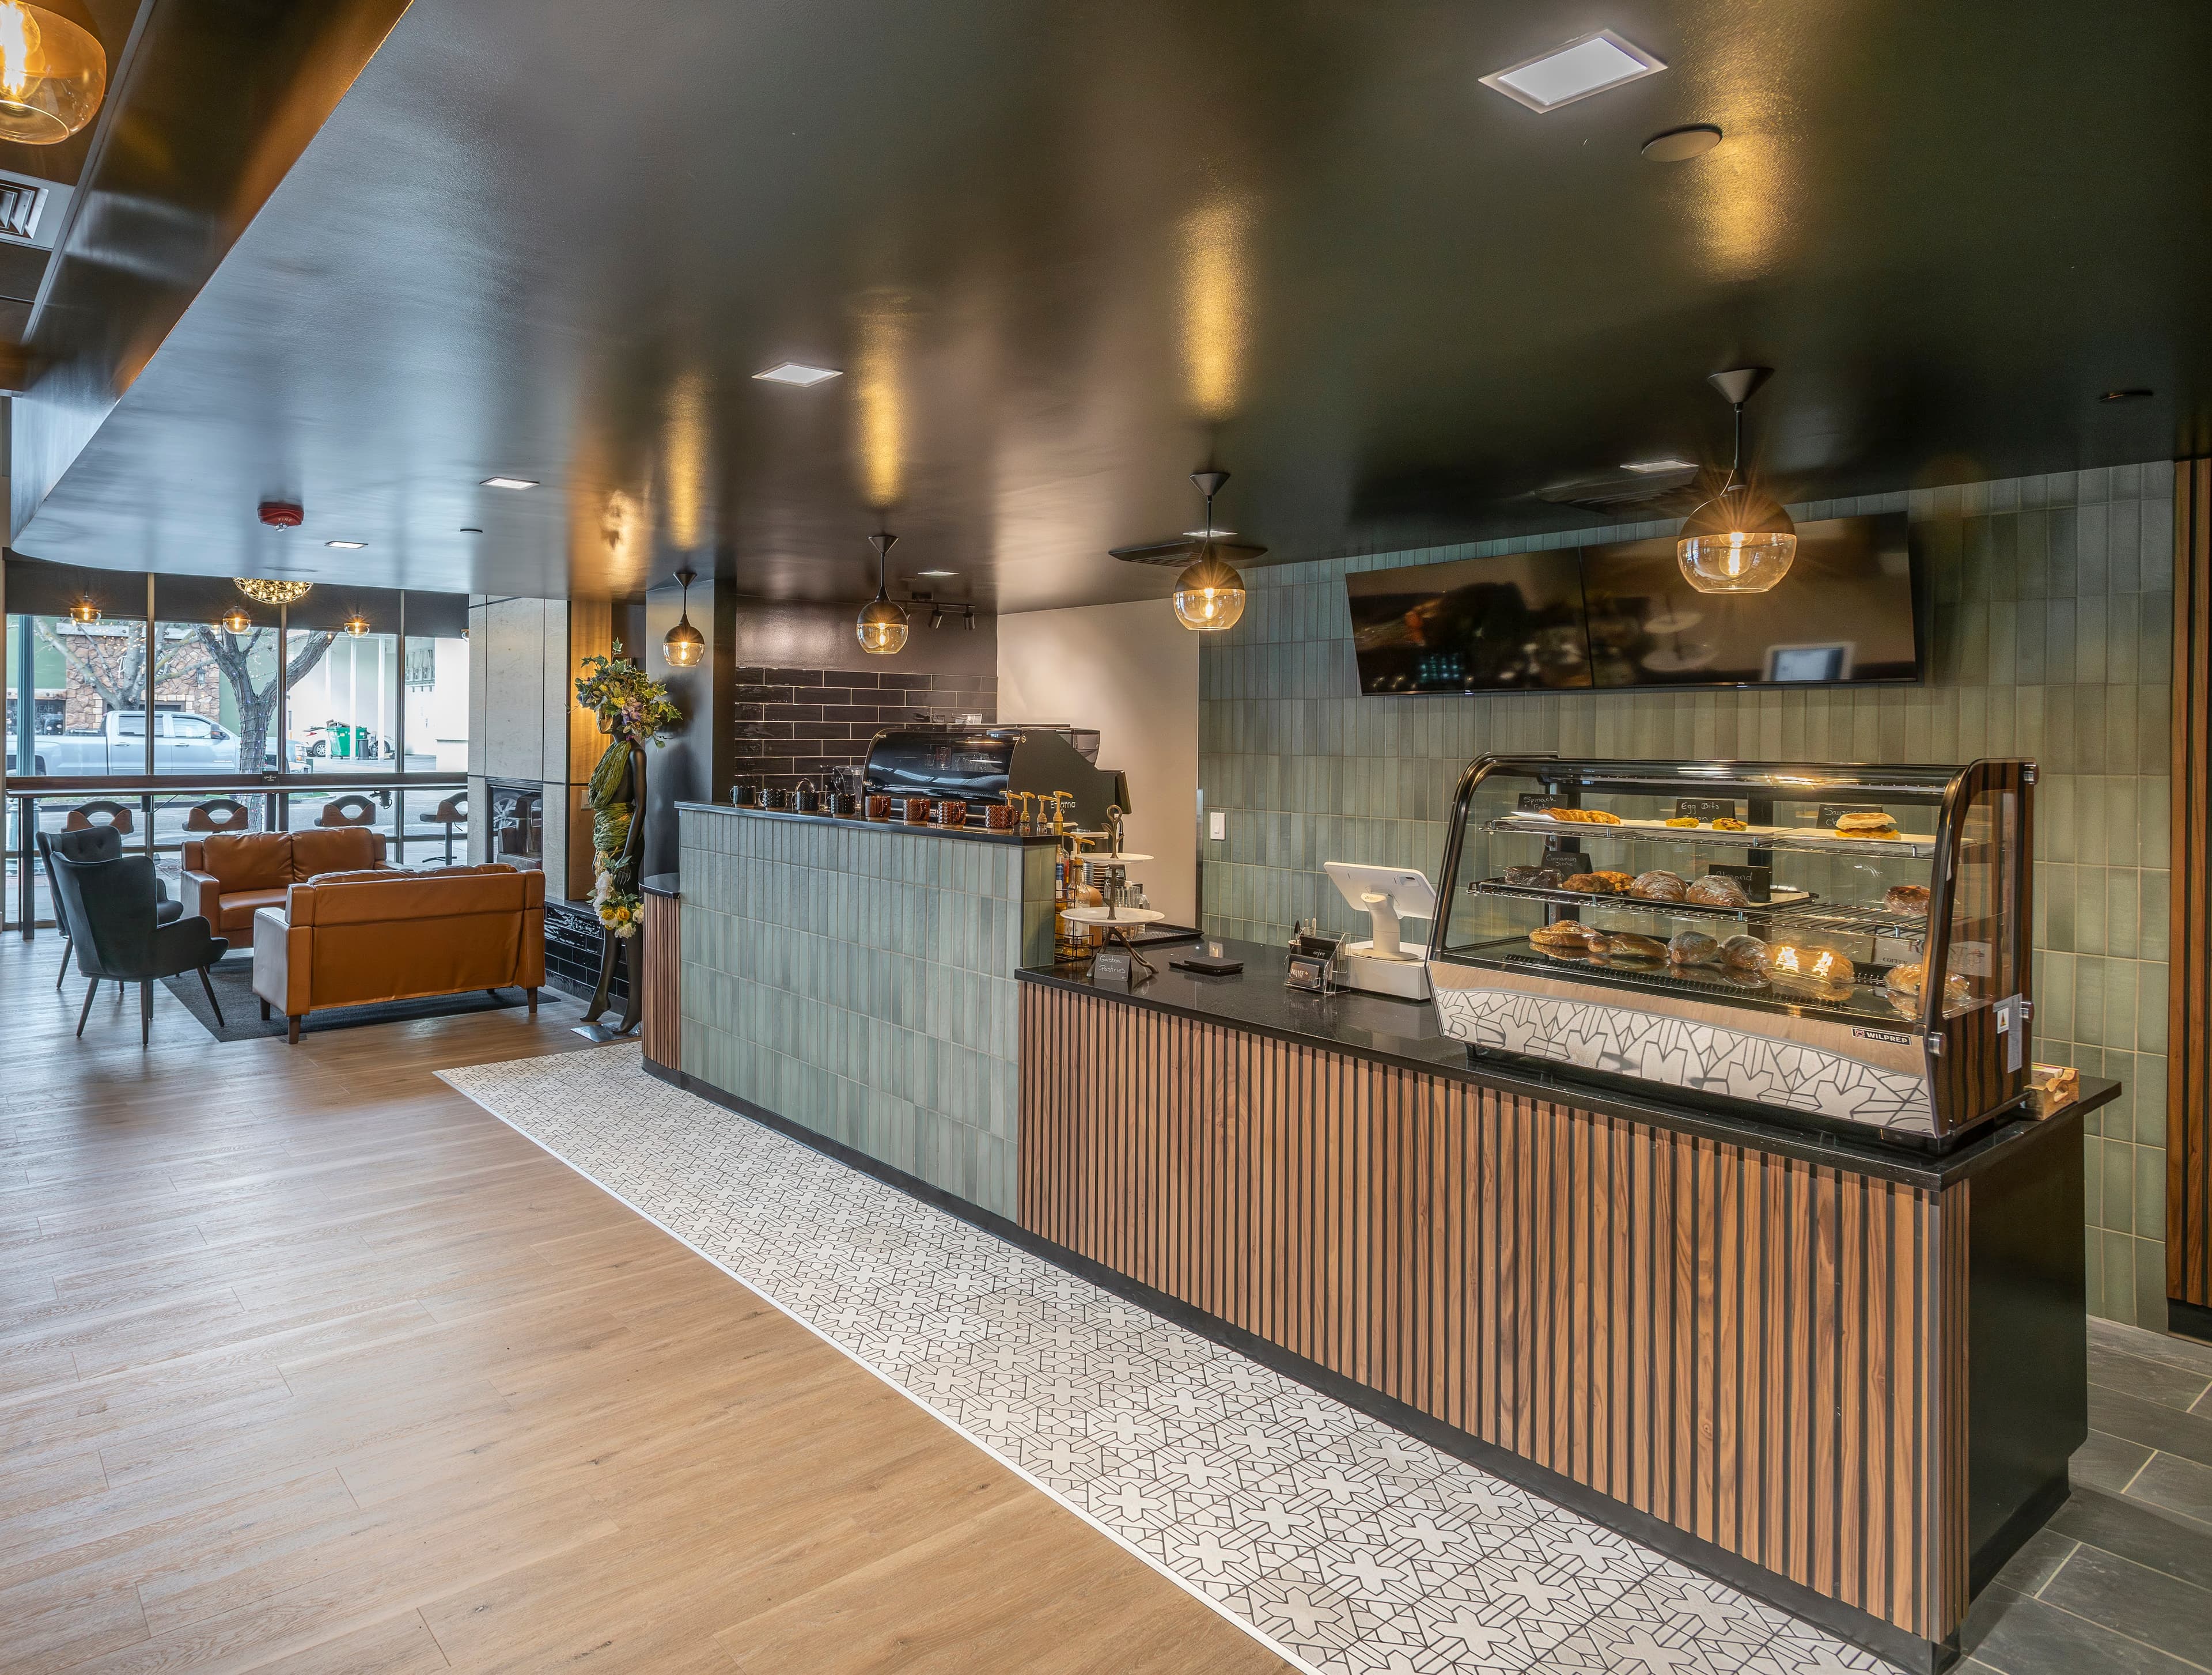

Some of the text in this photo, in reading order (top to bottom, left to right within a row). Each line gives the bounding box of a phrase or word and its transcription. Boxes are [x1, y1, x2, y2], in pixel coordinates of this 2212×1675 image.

[1523, 796, 1556, 806] Spinach
[1050, 801, 1076, 814] Engma
[1681, 802, 1696, 814] Egg
[1100, 955, 1123, 964] Gaston
[1099, 965, 1126, 973] Pastries
[1866, 1032, 1908, 1043] WILPREP
